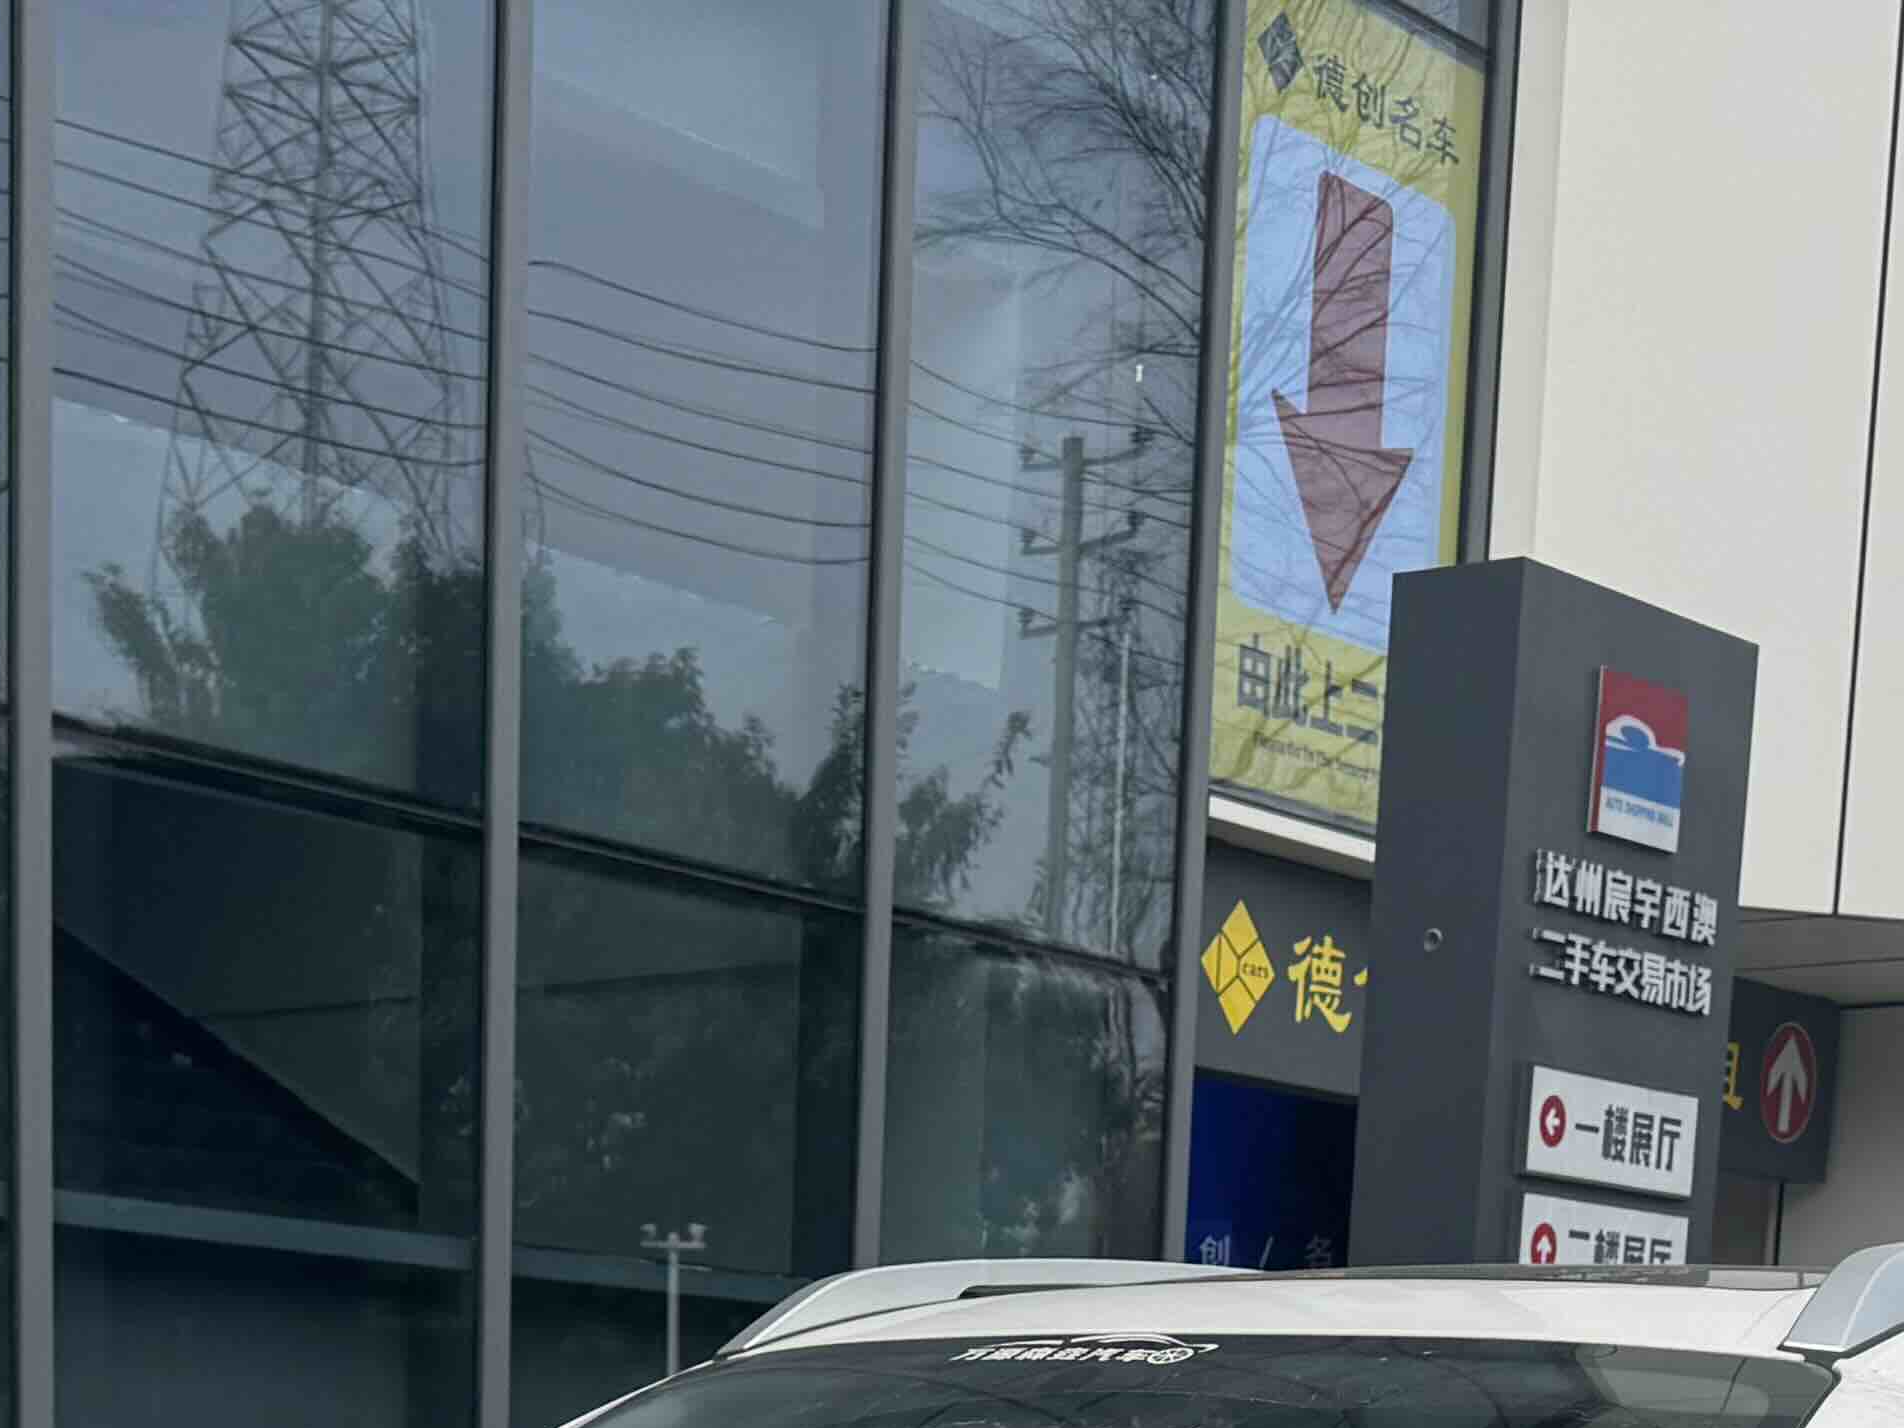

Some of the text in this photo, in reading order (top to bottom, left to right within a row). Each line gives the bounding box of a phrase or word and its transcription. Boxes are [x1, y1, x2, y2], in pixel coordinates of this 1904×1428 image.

[1312, 54, 1460, 166] 德创名车
[1287, 934, 1369, 1034] 德
[1534, 928, 1712, 1017] 二手车交易市场
